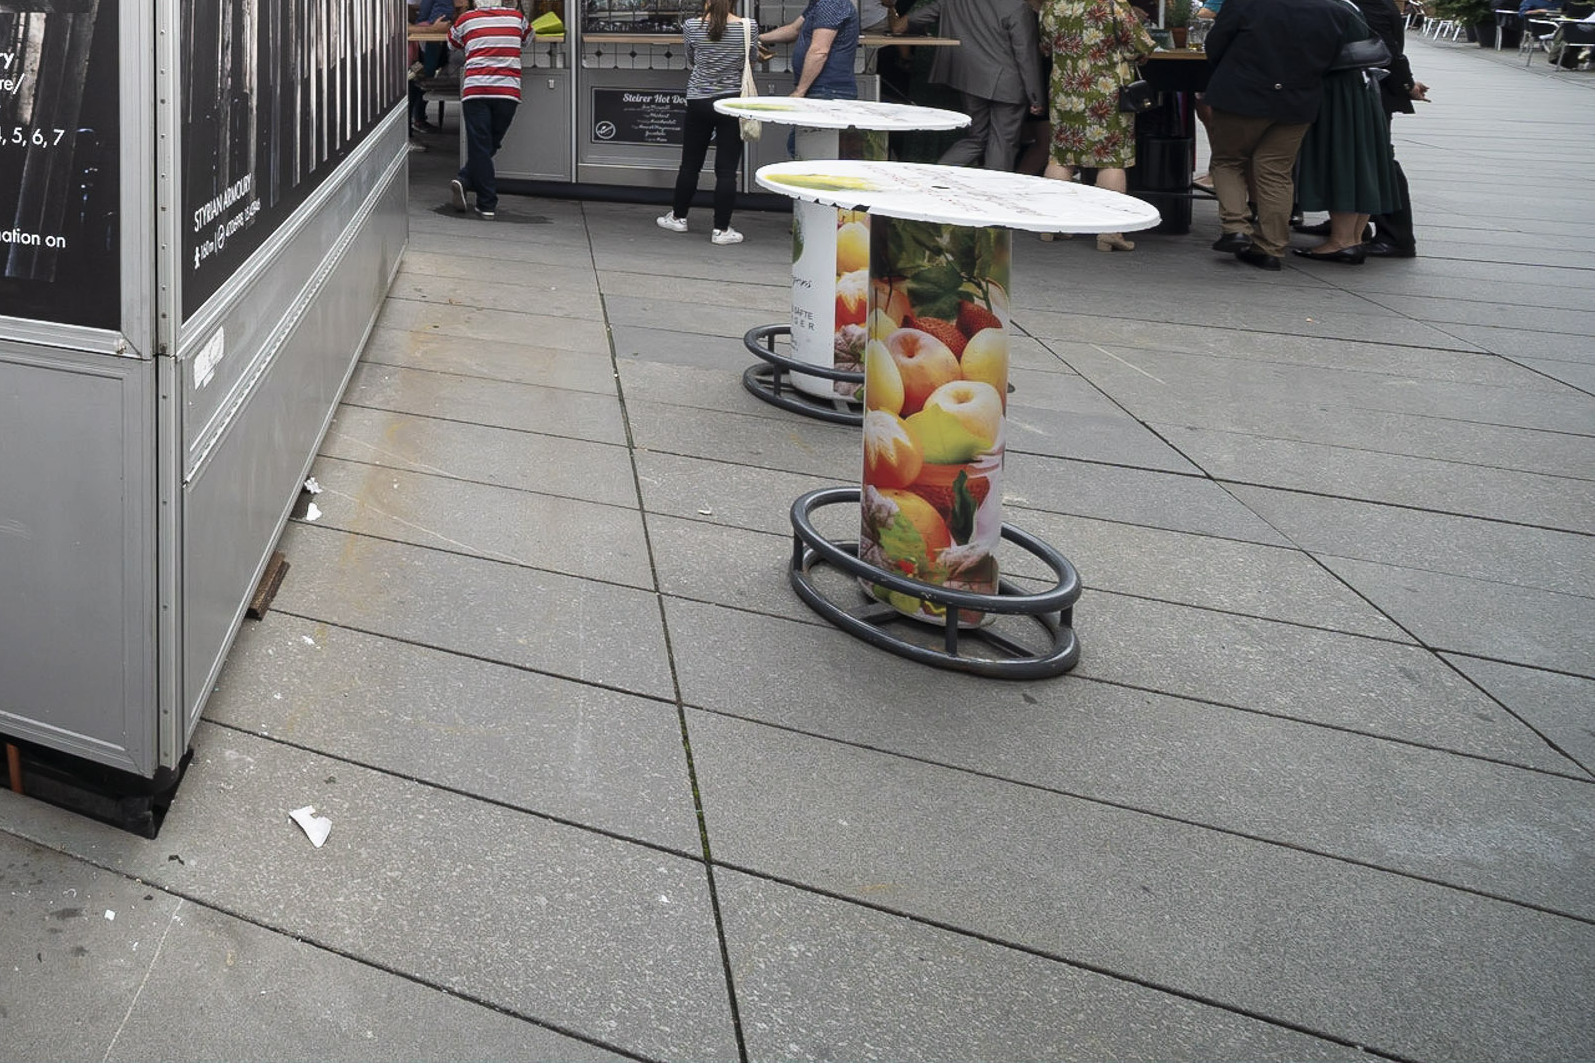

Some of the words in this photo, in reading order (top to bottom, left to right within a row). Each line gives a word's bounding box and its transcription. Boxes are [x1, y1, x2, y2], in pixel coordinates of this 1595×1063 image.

[622, 93, 653, 103] Steirer
[654, 94, 670, 104] Hot
[11, 127, 27, 147] 5,
[32, 128, 48, 148] 6,
[53, 129, 66, 146] 7
[194, 192, 223, 232] STYRIAN
[223, 172, 252, 211] ARMOURY
[45, 235, 66, 249] on
